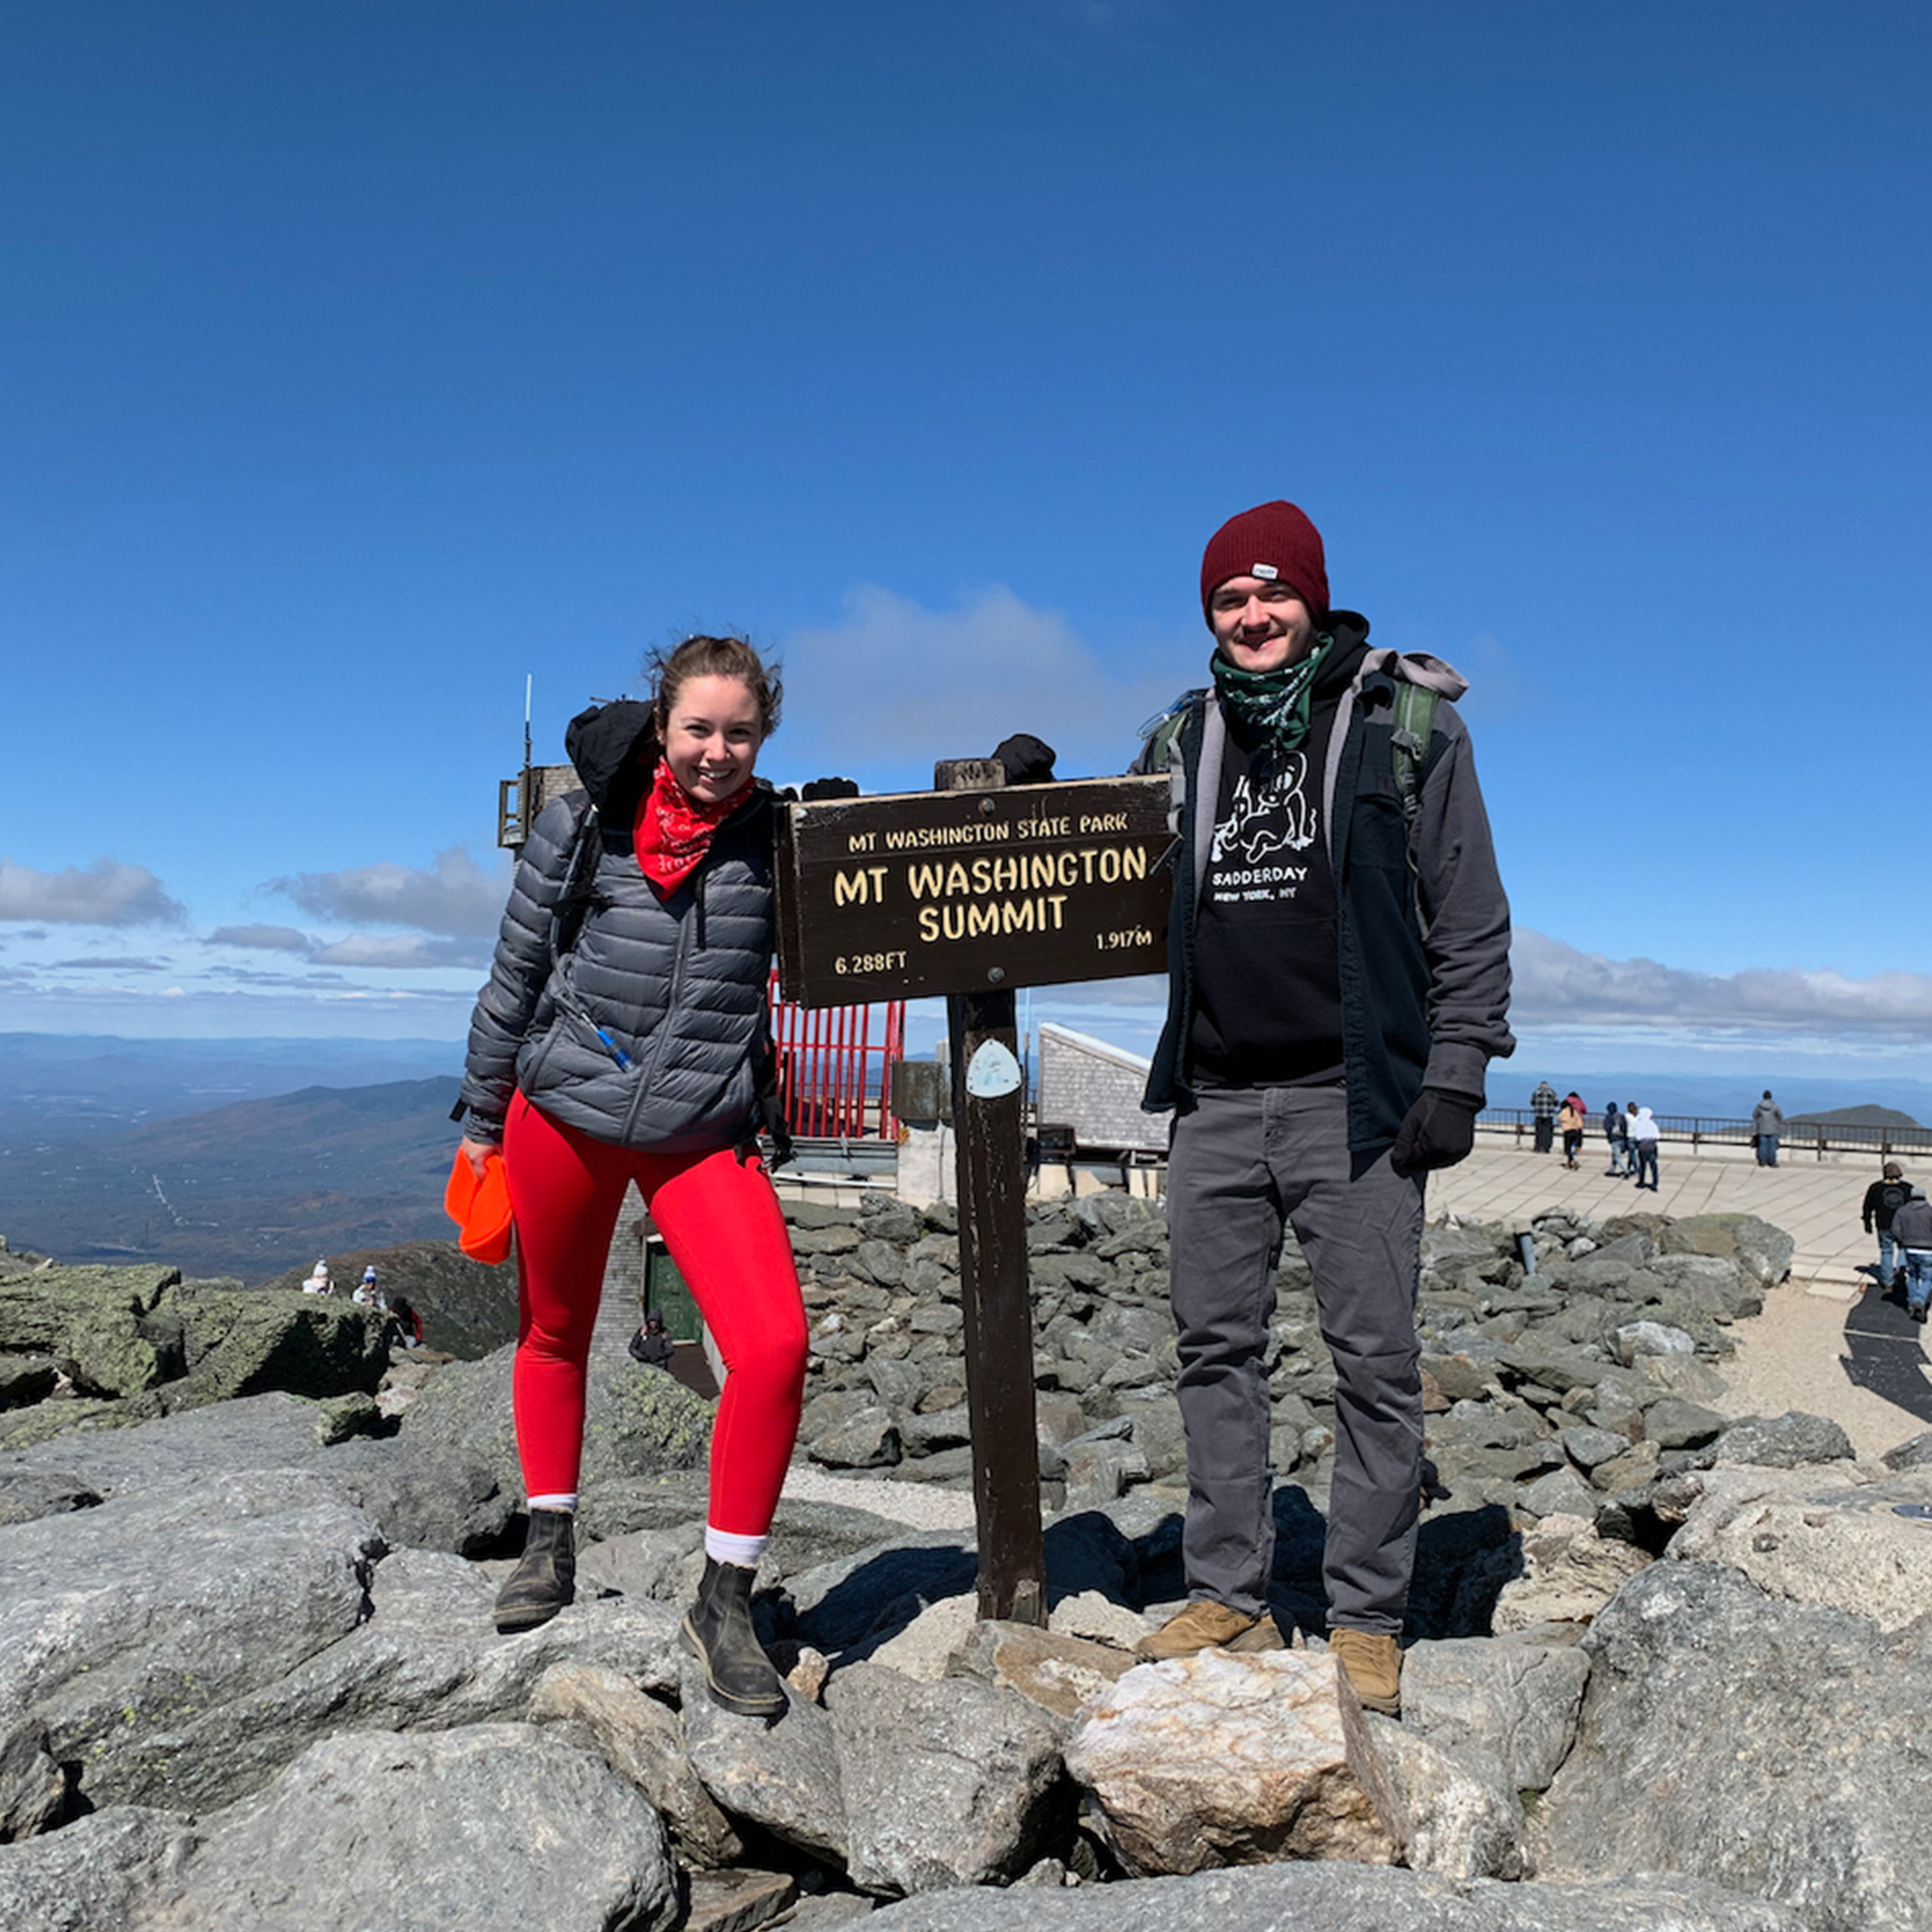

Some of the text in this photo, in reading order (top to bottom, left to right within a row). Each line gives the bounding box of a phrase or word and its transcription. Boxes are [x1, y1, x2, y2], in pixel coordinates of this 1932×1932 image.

[849, 812, 1128, 853] MT WASHINGTON STATE PARK
[834, 846, 1147, 907] MT WASHINGTON
[1212, 867, 1307, 886] SADDERDAY
[1213, 892, 1240, 902] NEW
[1279, 887, 1296, 898] NY
[919, 895, 1067, 942] SUMMIT
